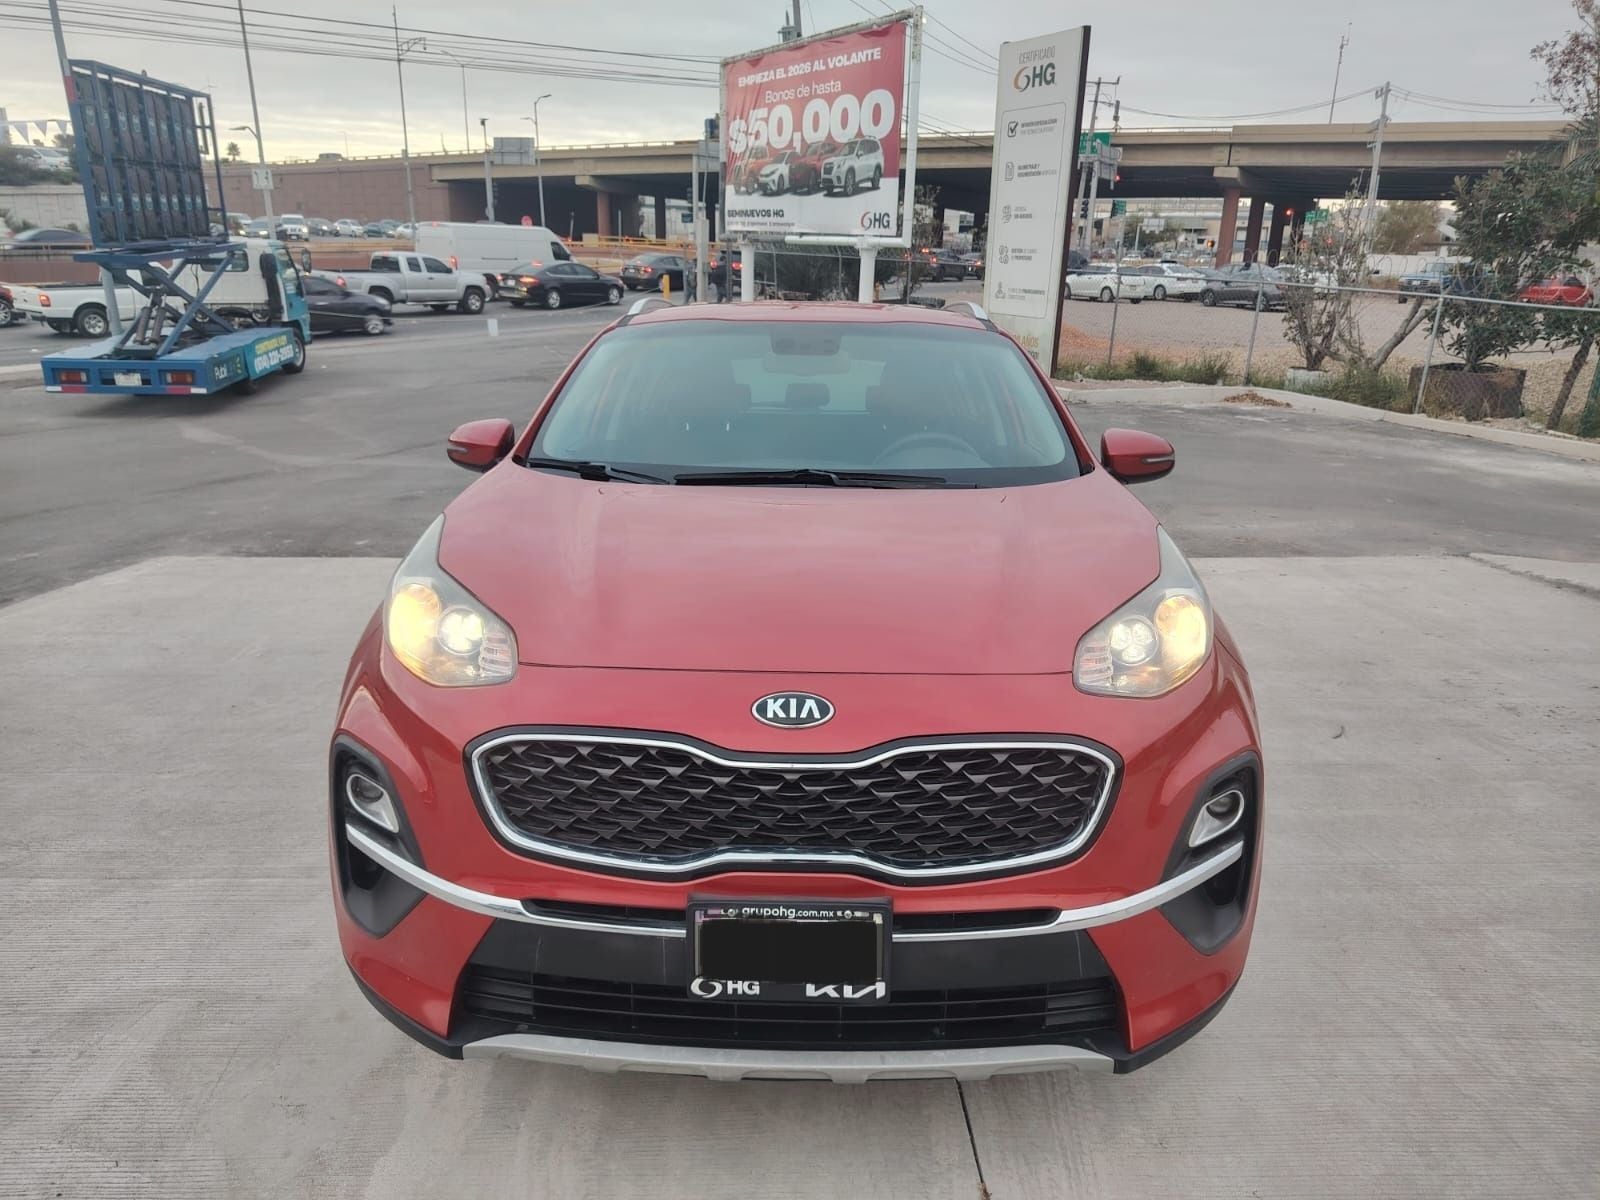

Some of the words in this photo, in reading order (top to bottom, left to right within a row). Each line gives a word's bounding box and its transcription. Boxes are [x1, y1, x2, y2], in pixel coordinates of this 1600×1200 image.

[1018, 45, 1056, 64] CERTIFICADO
[738, 69, 775, 87] EMPIEZA
[775, 67, 787, 79] EL
[788, 62, 811, 77] 2026
[812, 59, 826, 71] AL
[827, 48, 881, 69] VOLANTE
[1031, 62, 1056, 88] HG
[765, 88, 796, 104] Bonos
[796, 84, 810, 97] de
[811, 79, 842, 96] hasta
[728, 89, 895, 153] $50,000
[727, 209, 772, 218] SEMINUEVOS
[772, 209, 785, 218] HG
[873, 212, 890, 229] HG
[766, 698, 821, 719] KIA
[742, 906, 834, 919] grupohg.com.mx
[727, 980, 760, 995] HG
[805, 981, 886, 1000] KIA
